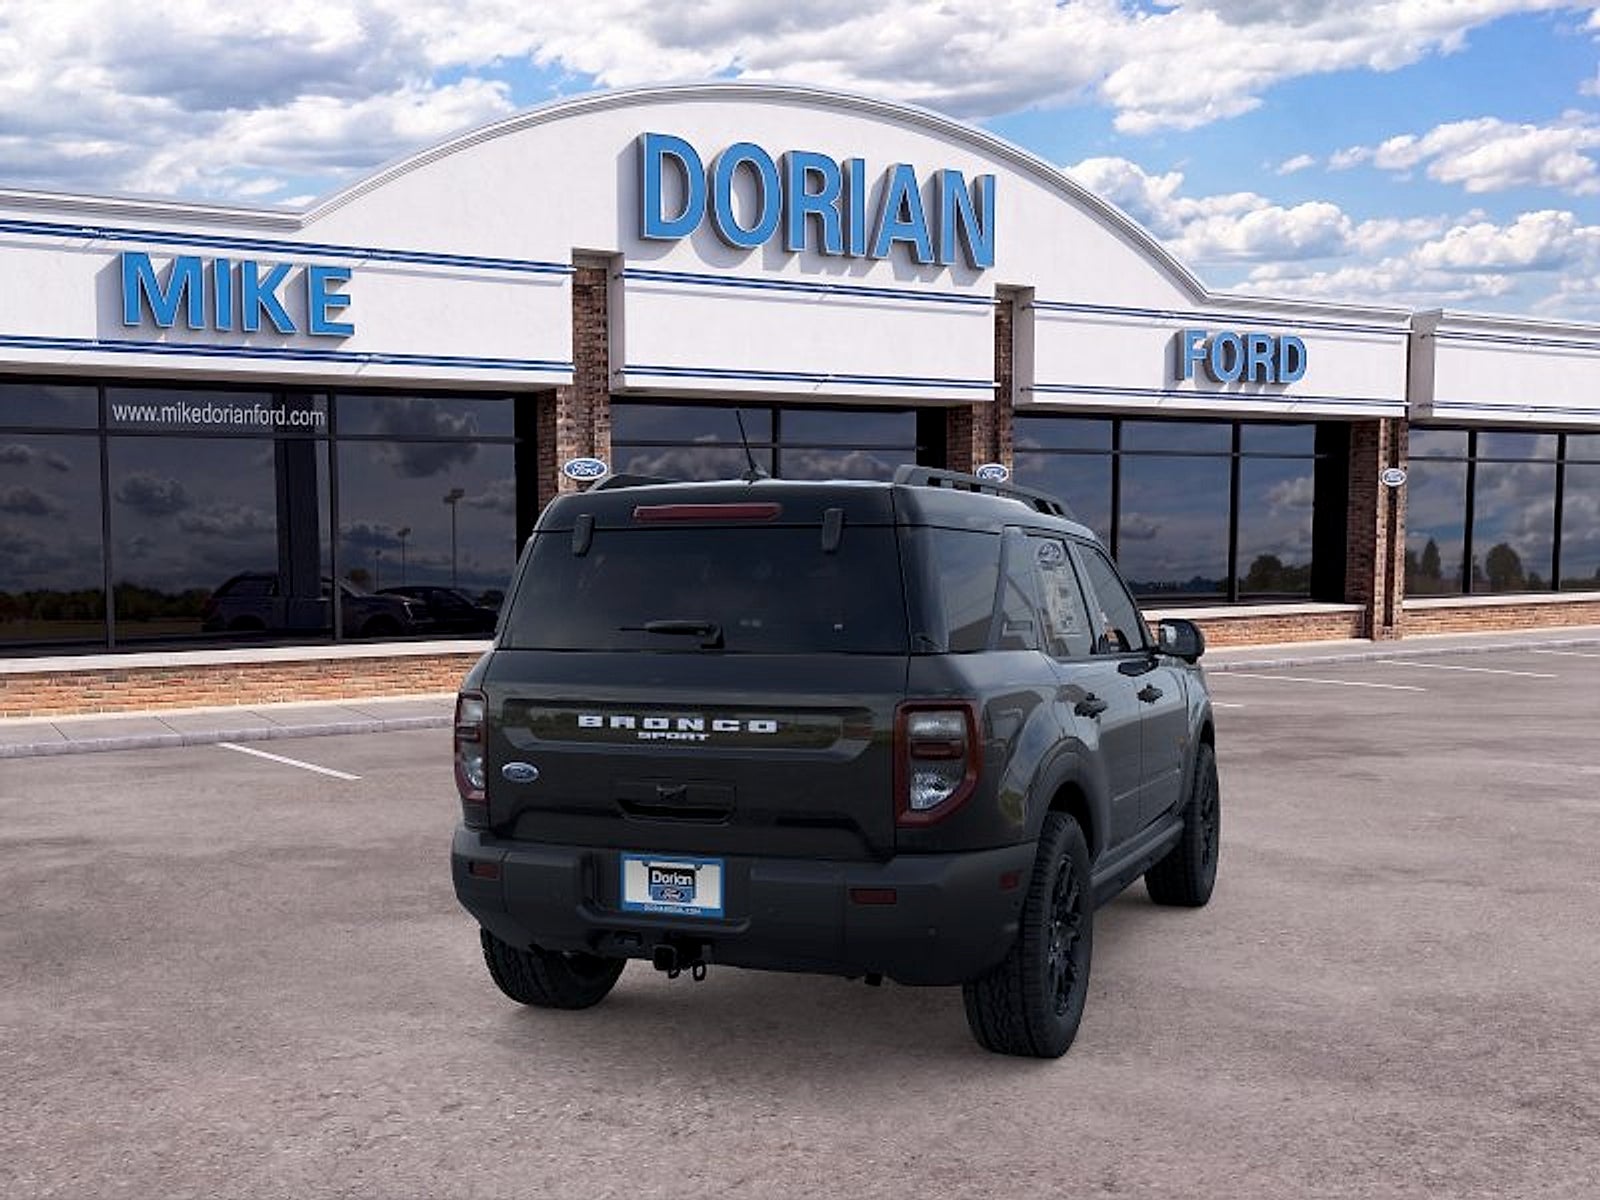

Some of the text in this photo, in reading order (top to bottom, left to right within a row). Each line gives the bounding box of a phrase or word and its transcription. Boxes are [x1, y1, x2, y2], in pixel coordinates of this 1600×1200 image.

[640, 132, 996, 270] DORIAN
[121, 251, 355, 337] MIKE
[1176, 327, 1308, 384] FORD
[111, 402, 326, 427] www.mikedorianford.com
[578, 715, 778, 733] BRONCO
[637, 731, 710, 741] SPORT
[651, 870, 692, 886] Dorian
